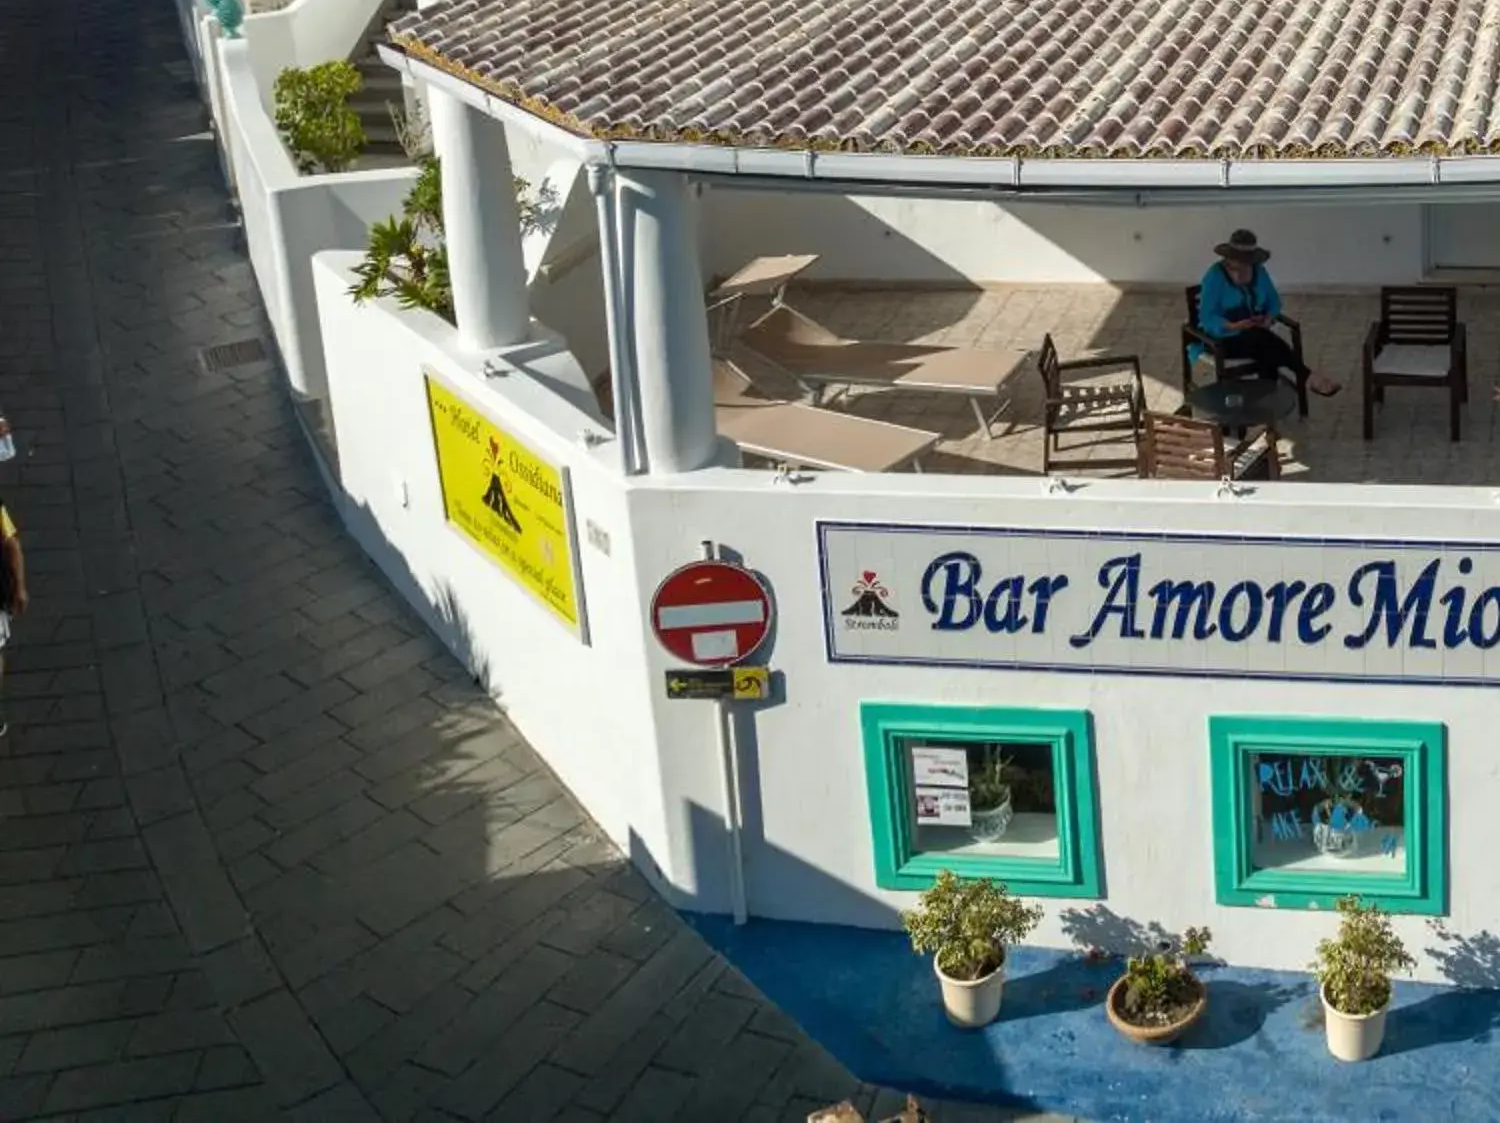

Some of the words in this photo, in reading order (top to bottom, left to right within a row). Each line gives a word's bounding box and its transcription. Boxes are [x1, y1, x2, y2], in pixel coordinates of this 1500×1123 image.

[921, 551, 1068, 633] Bar
[1069, 552, 1335, 648] Amore
[844, 617, 899, 631] Stromboli
[1258, 757, 1328, 797] RELAX
